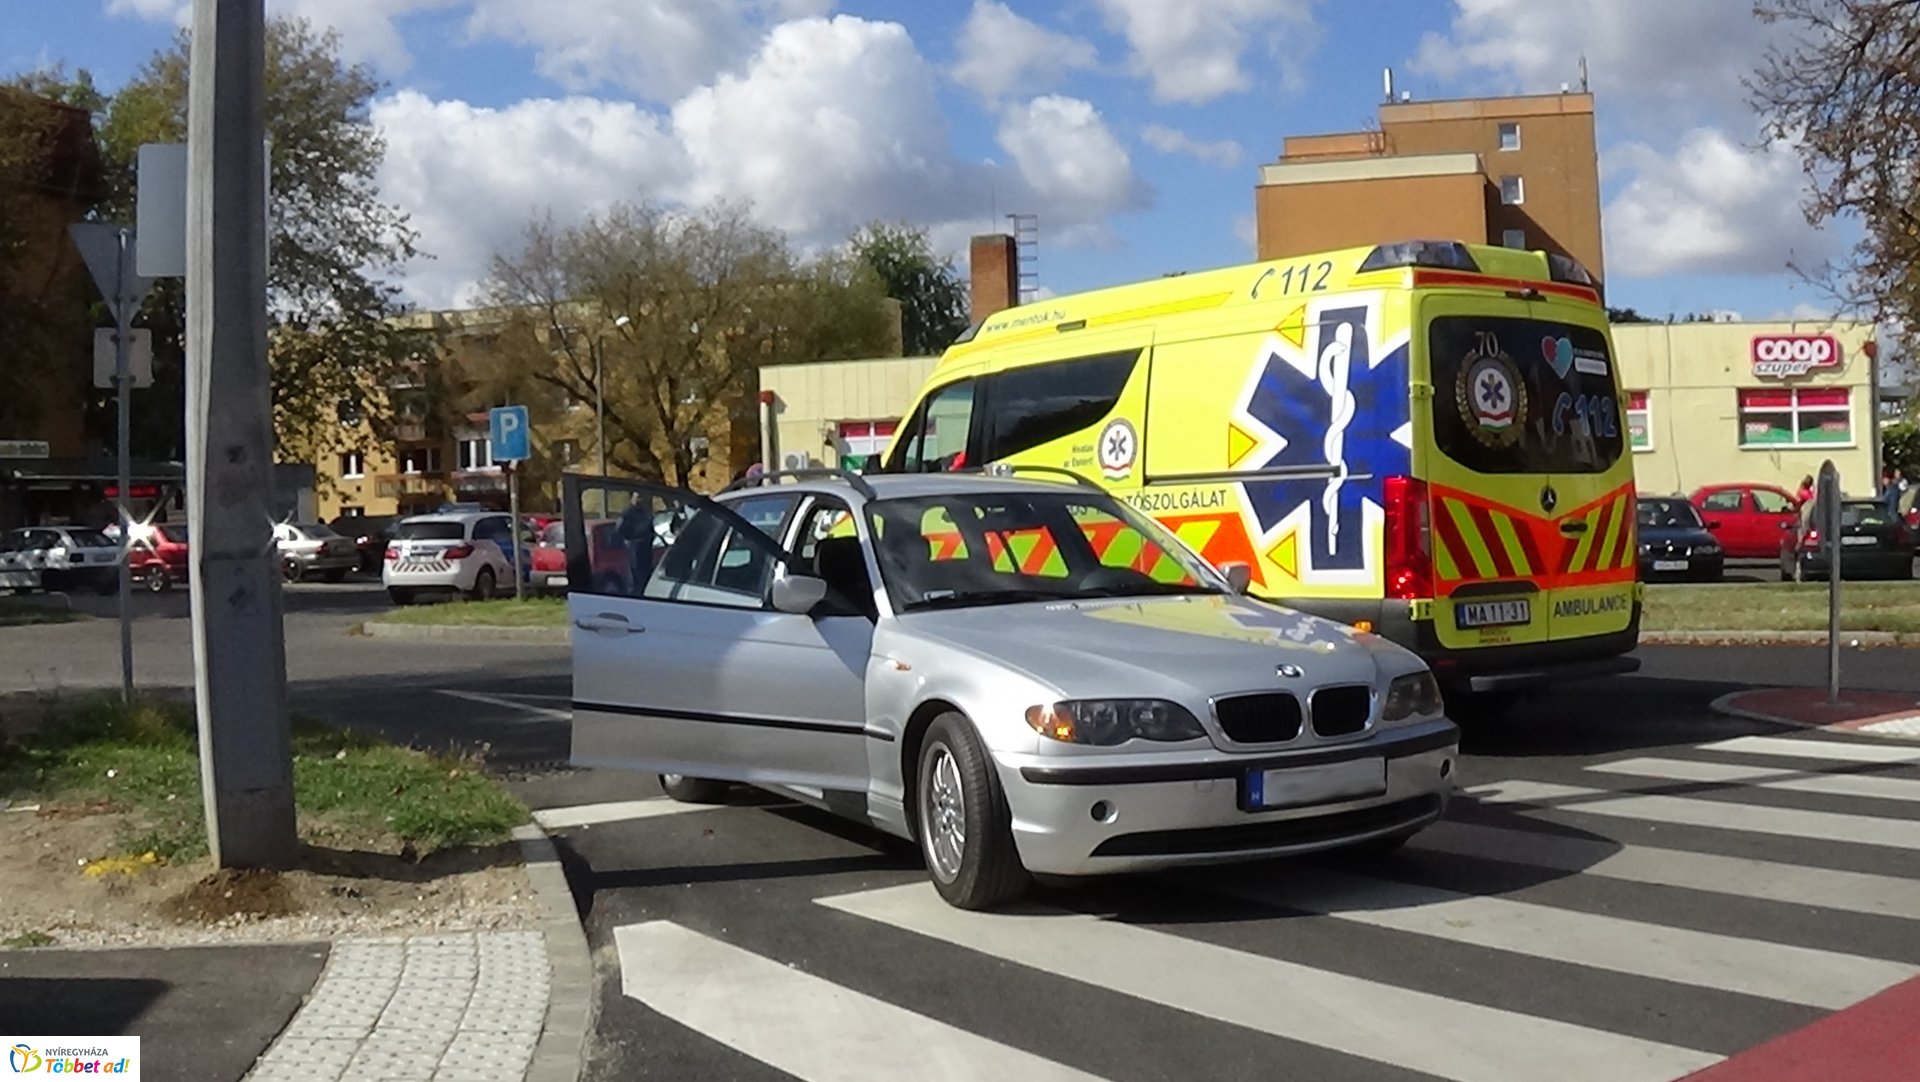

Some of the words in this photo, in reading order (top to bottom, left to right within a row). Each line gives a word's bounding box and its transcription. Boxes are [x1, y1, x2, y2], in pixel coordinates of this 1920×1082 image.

[1281, 260, 1333, 295] 112
[1475, 331, 1499, 357] 70
[1757, 338, 1831, 366] coop
[1755, 363, 1809, 376] szuper
[500, 412, 518, 444] P
[1575, 393, 1617, 438] 112
[1468, 605, 1488, 622] MA
[1491, 601, 1527, 620] 11-31
[1554, 594, 1627, 617] AMBULANCE
